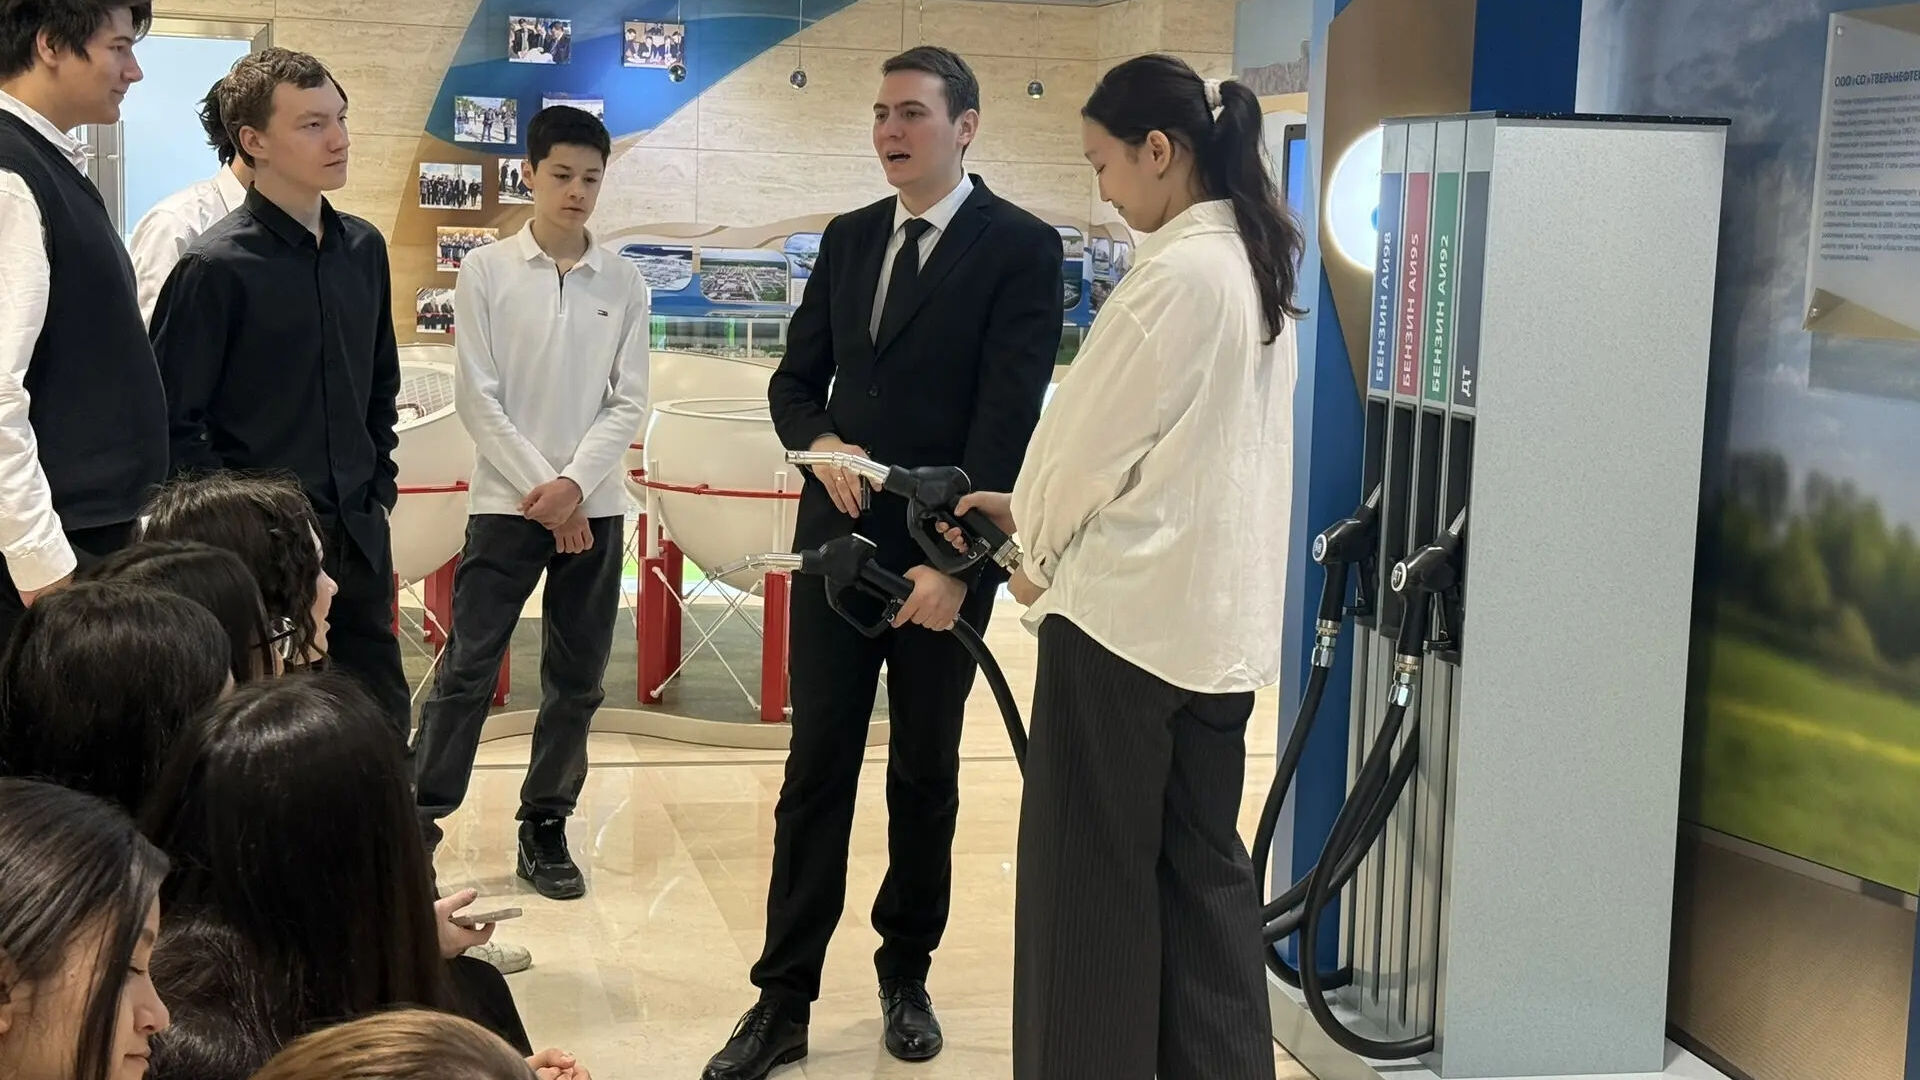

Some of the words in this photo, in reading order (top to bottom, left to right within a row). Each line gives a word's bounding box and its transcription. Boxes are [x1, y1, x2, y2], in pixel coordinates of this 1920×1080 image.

[1835, 75, 1851, 87] ООО
[1381, 232, 1392, 289] АИ98
[1408, 233, 1419, 292] АИ95
[1438, 234, 1449, 295] АИ92
[1376, 295, 1388, 382] БЕНЗИН
[1402, 298, 1415, 387] БЕНЗИН
[1432, 301, 1445, 393] БЕНЗИН
[1461, 365, 1471, 398] ДТ
